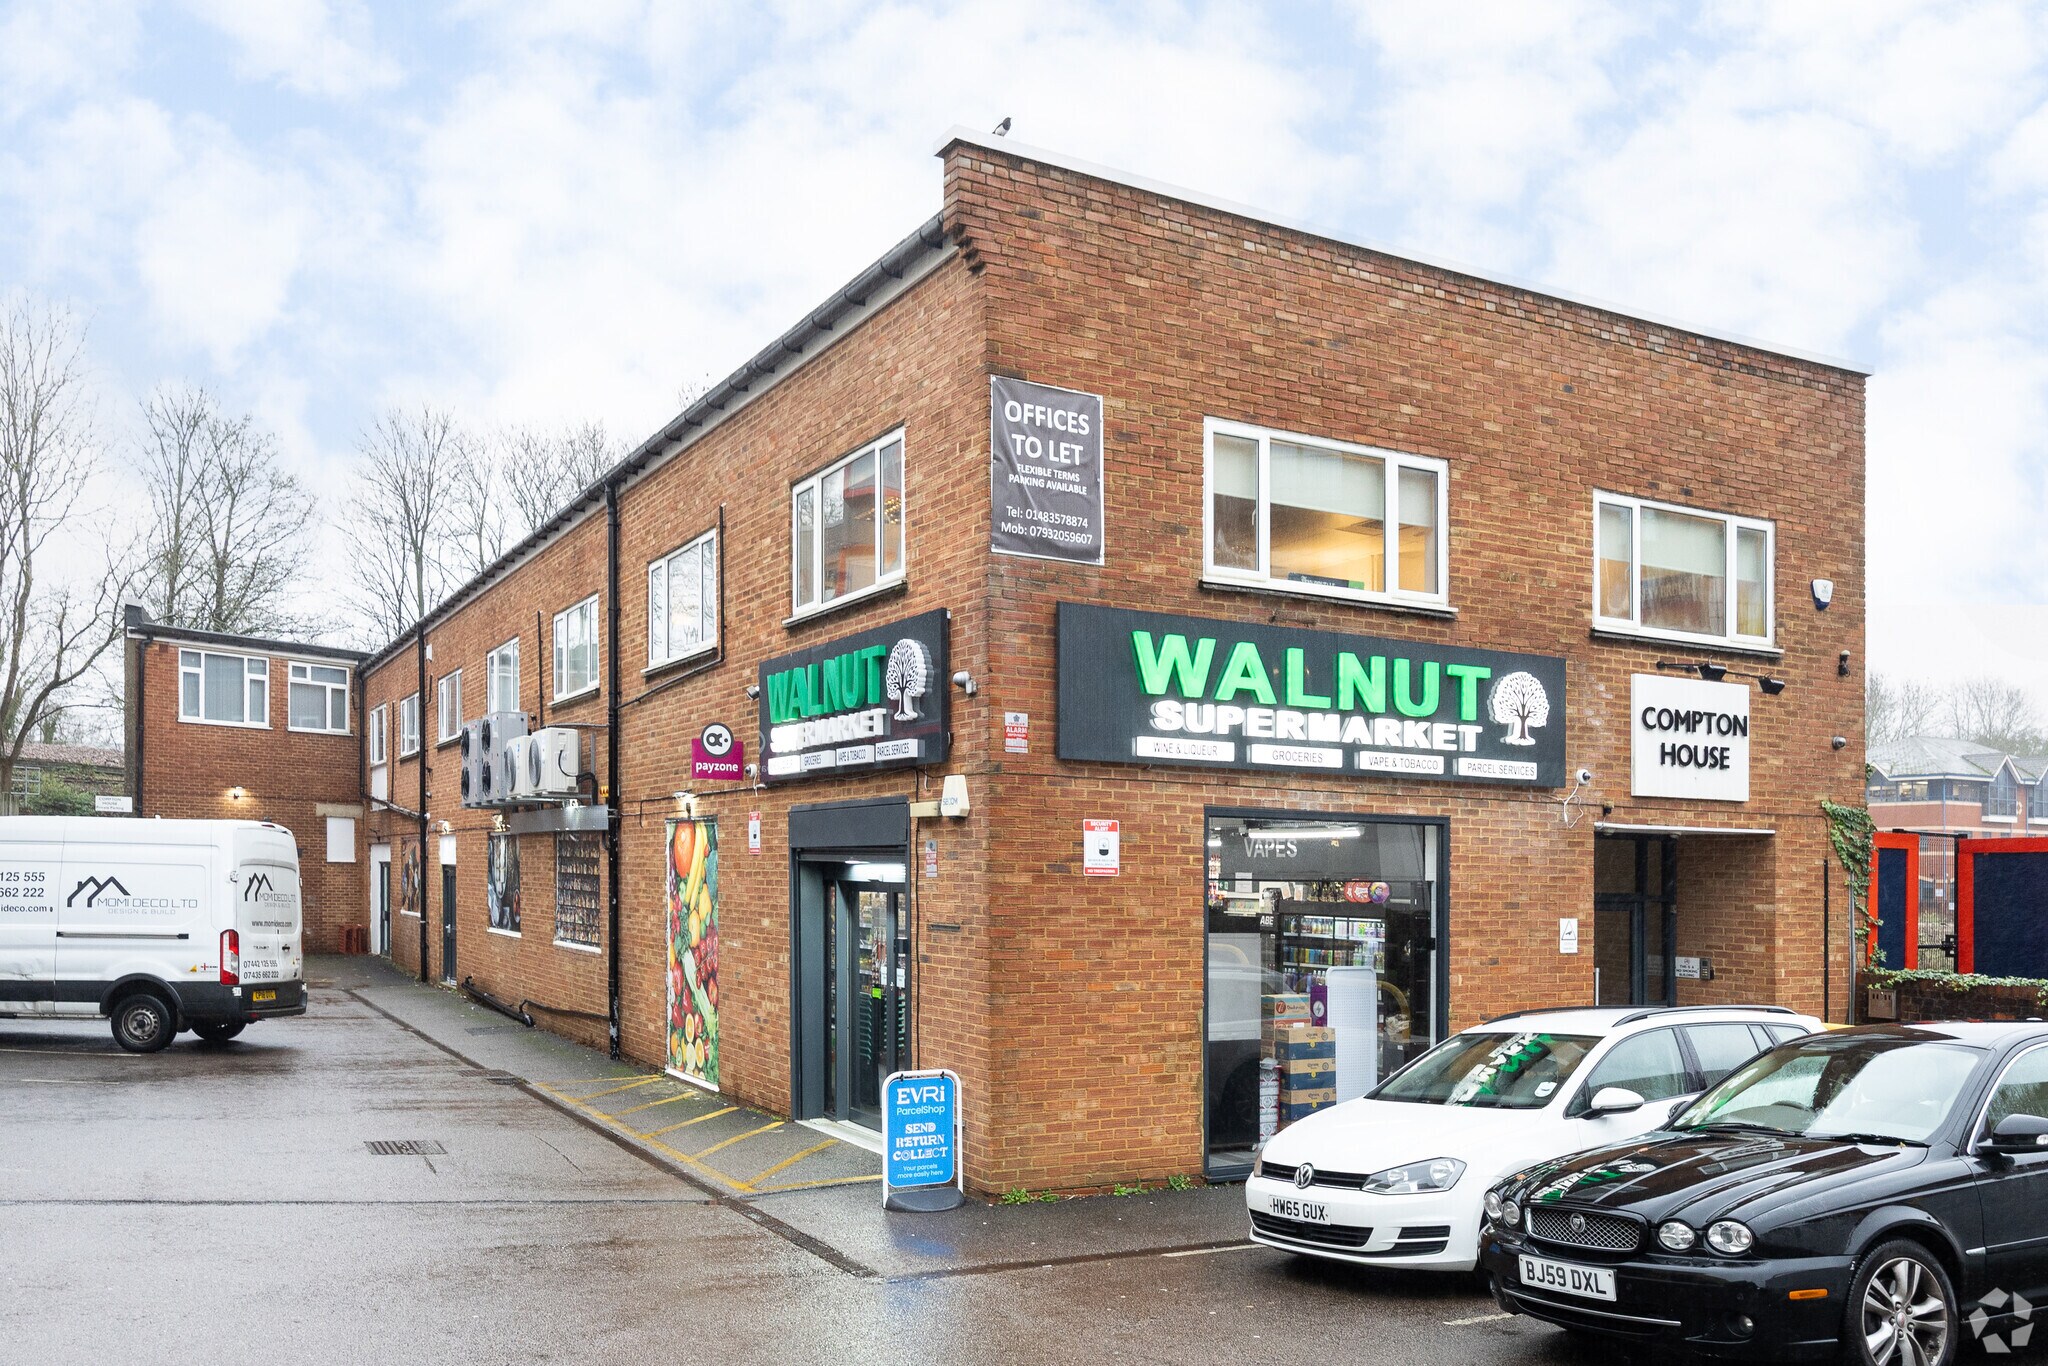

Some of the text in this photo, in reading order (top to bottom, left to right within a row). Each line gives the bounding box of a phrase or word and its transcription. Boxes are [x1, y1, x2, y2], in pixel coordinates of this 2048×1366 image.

[1004, 400, 1090, 435] OFFICES
[1012, 434, 1083, 465] TO LET
[1017, 463, 1080, 482] FLEXIBLE TERMS
[1009, 474, 1087, 495] PARKING AVAILABLE
[1006, 506, 1088, 529] Tel: 01483578874
[1001, 521, 1092, 545] Mob: 07932059607
[1131, 630, 1491, 721] WALNUT
[767, 644, 886, 724] WALNUT
[1150, 700, 1483, 751] SUPERMARKET
[1641, 707, 1747, 736] COMPTON
[770, 708, 887, 753] SERMARKET
[850, 749, 866, 760] TOBACCO
[877, 742, 909, 757] PARCEL SERVICES
[1153, 742, 1218, 757] WINE & LIQUEUR
[1272, 750, 1323, 763] GROCERIES
[1660, 742, 1730, 770] HOUSE
[804, 754, 821, 766] GROCERIES
[1369, 756, 1438, 770] VAPE & TOBACCO
[696, 762, 738, 774] payzone
[1467, 763, 1535, 777] PARCEL SERVICES
[1244, 838, 1298, 858] VAPES
[0, 872, 45, 882] 125 555
[23, 888, 44, 897] 222
[1, 904, 47, 912] ideco.com
[97, 898, 197, 908] MOMI DECO LTD
[1260, 915, 1274, 925] ABE
[244, 960, 260, 968] 07442
[897, 1105, 945, 1116] ParcelShop
[905, 1122, 936, 1134] SEND
[895, 1135, 945, 1148] RETURN
[893, 1146, 948, 1162] COLLECT
[917, 1163, 938, 1172] parcels
[1273, 1198, 1326, 1221] HW65 GUX
[1525, 1260, 1607, 1295] BJ59 DXL
